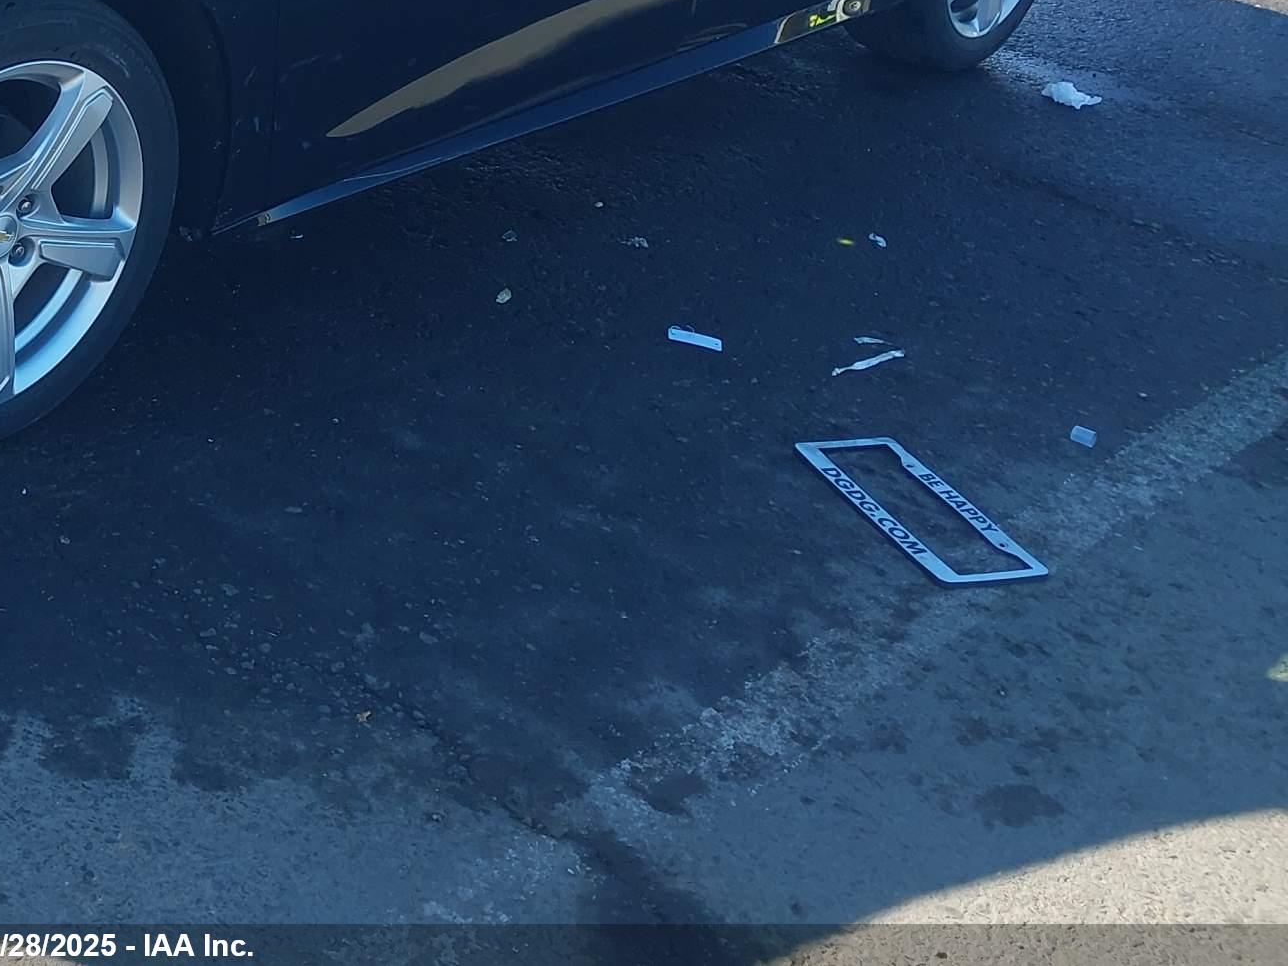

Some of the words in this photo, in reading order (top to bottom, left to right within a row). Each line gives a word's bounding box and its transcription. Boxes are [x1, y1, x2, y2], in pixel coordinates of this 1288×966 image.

[821, 467, 928, 556] DGDG.COM
[918, 473, 943, 491] BE
[940, 490, 999, 533] HAPPY
